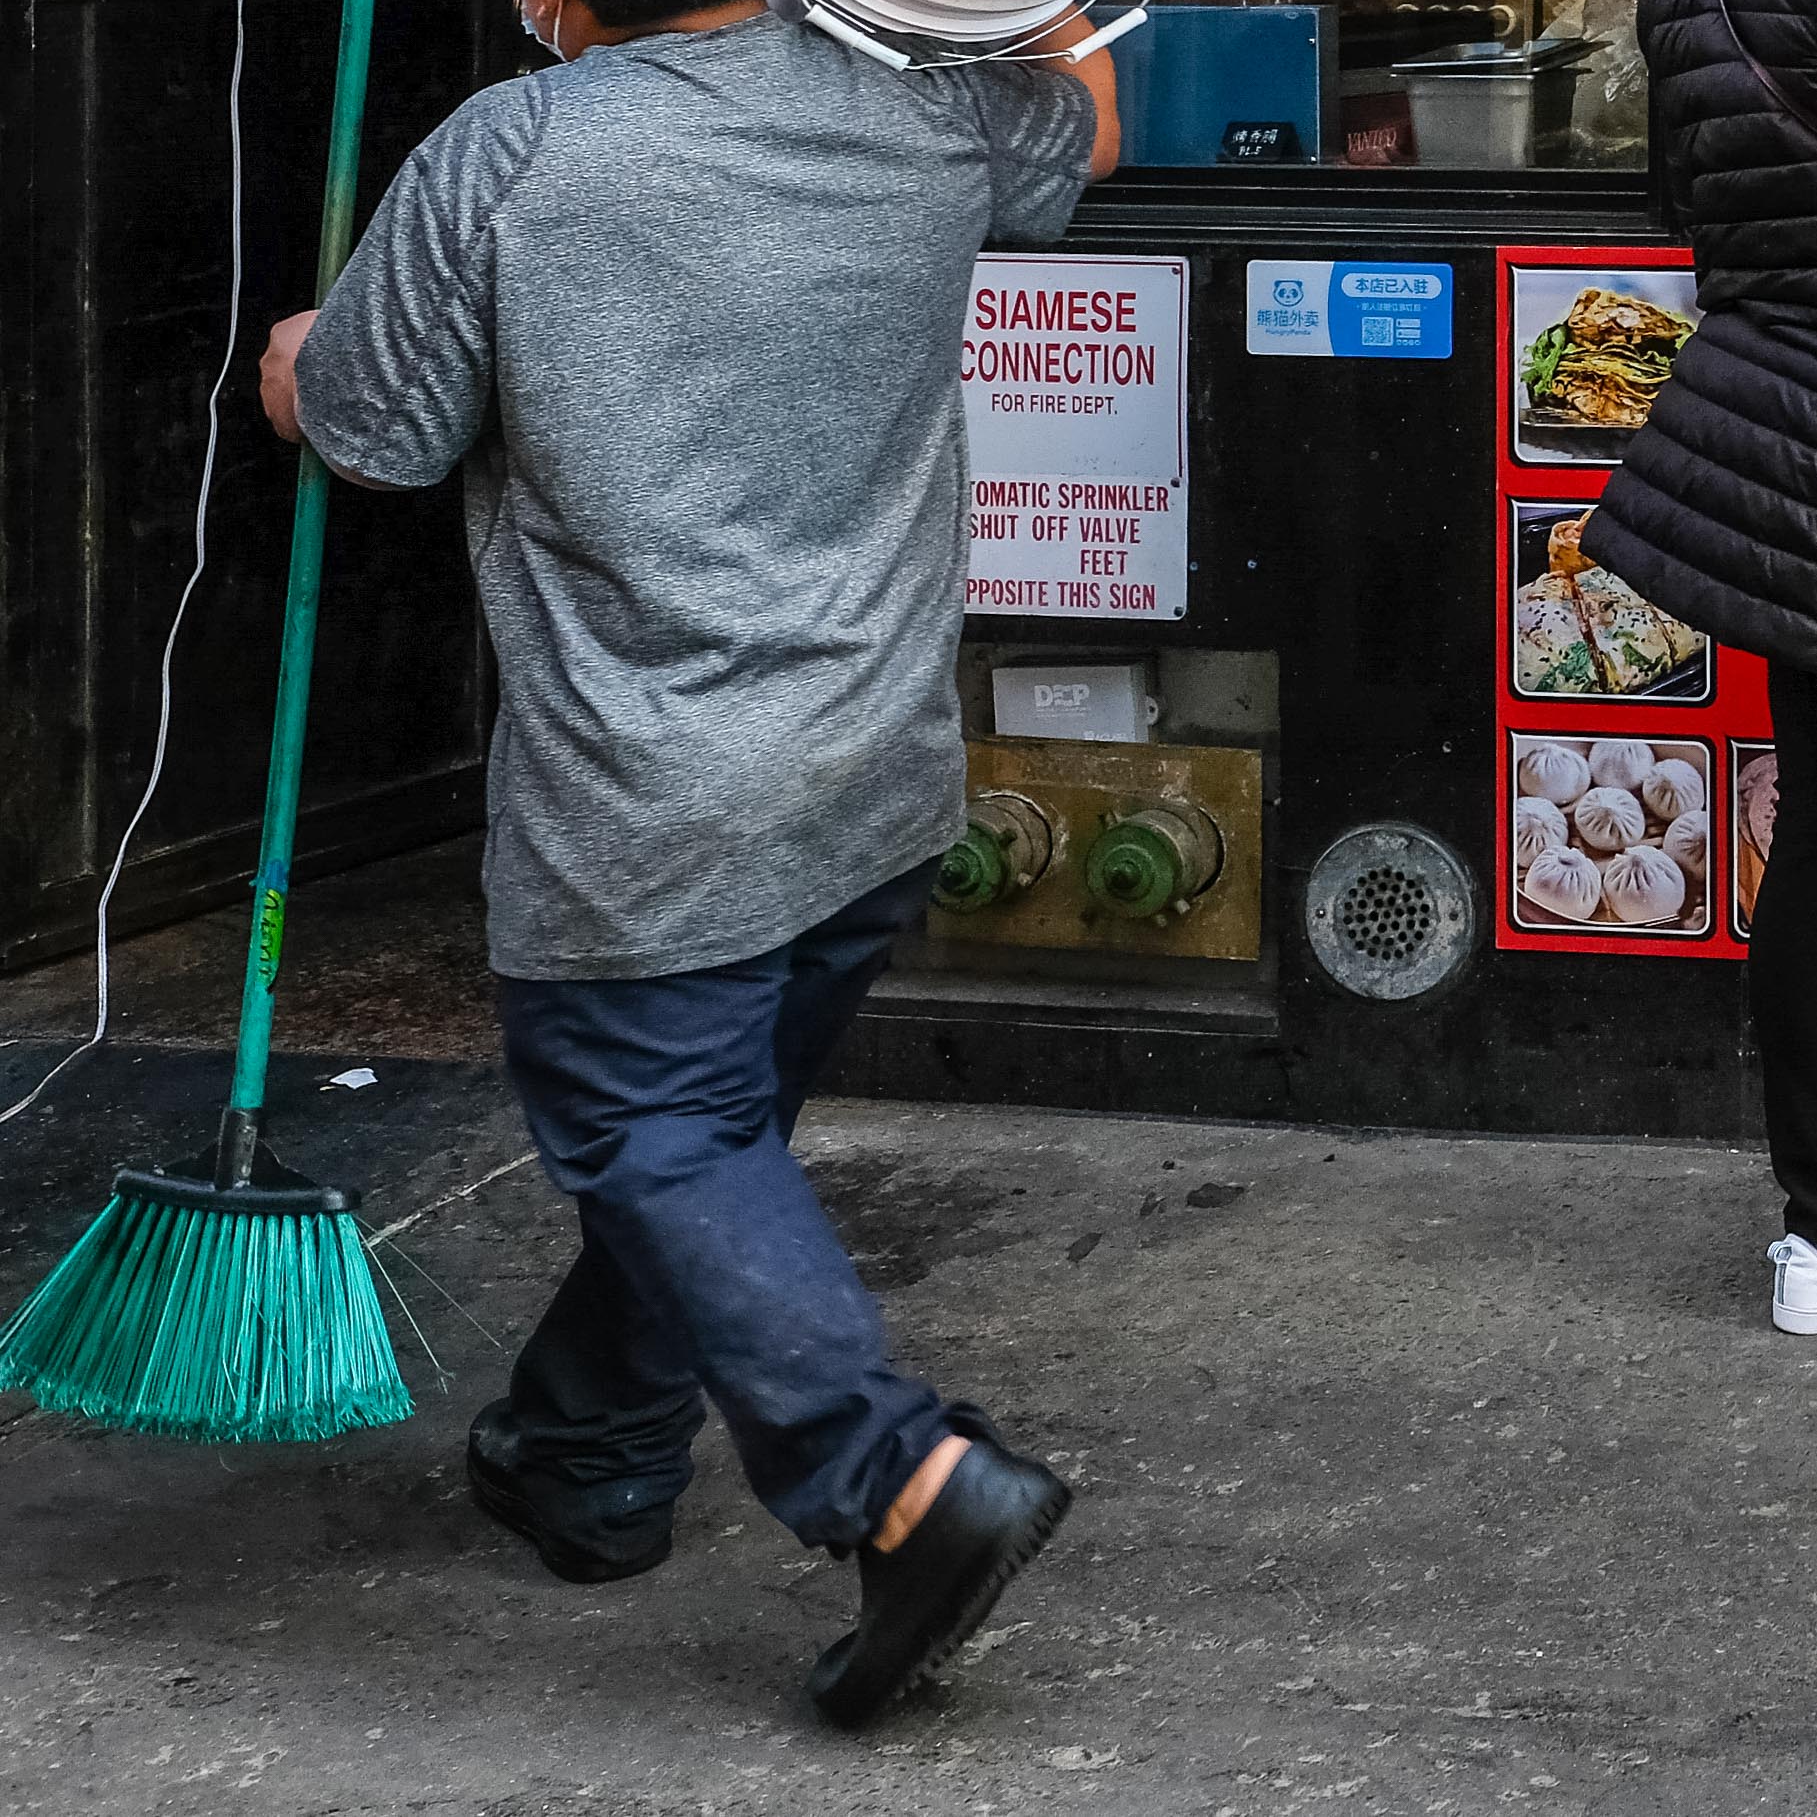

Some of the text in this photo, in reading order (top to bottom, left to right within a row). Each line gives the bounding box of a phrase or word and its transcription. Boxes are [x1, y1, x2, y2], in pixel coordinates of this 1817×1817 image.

[1355, 278, 1428, 295] 本店已入驻
[975, 288, 1136, 332] SIAMESE
[1257, 309, 1320, 327] 熊猫外卖
[960, 340, 1154, 385] CONNECTION
[991, 394, 1118, 414] FOR FIRE DEPT.
[1058, 482, 1169, 511] SPRINKLER
[969, 513, 1141, 543] SHUT OFF VALVE
[1080, 550, 1128, 575] FEET
[1056, 581, 1100, 608] THIS
[1110, 583, 1156, 610] SIGN
[1034, 684, 1090, 707] DEP
